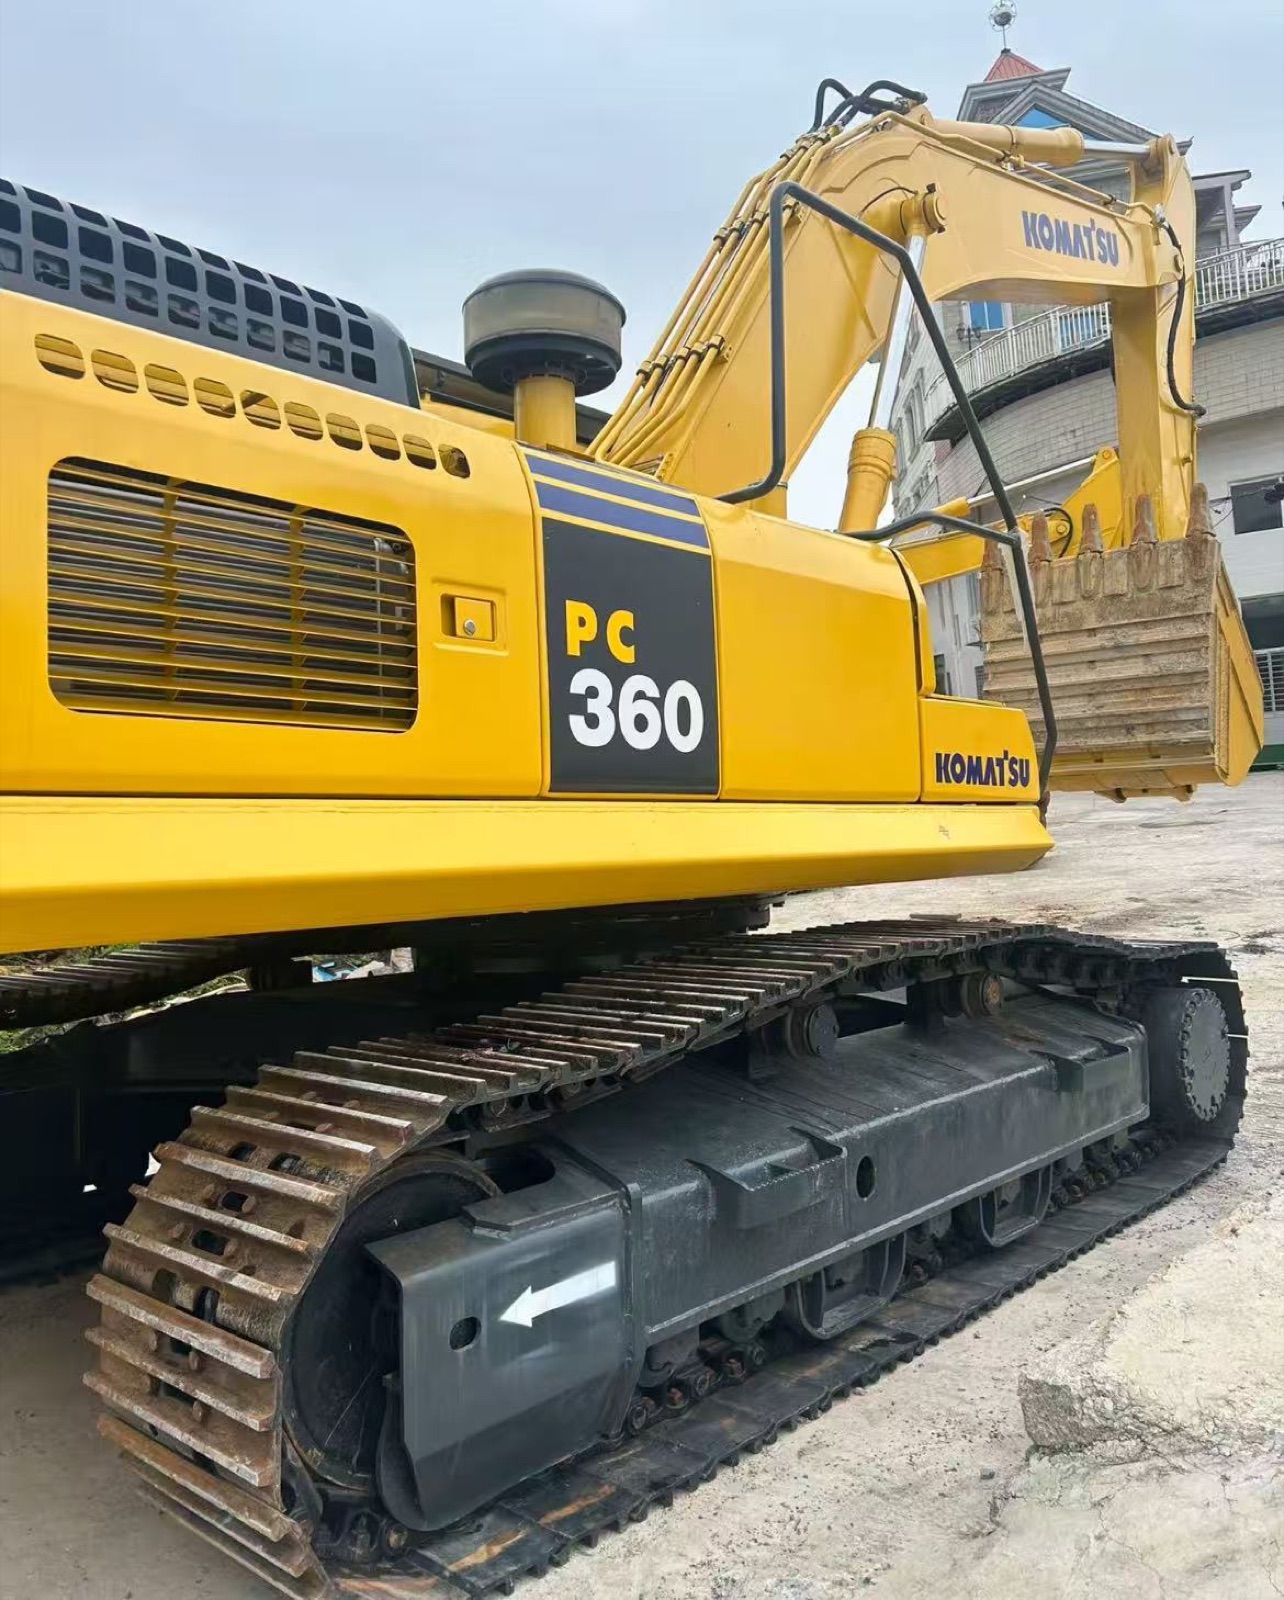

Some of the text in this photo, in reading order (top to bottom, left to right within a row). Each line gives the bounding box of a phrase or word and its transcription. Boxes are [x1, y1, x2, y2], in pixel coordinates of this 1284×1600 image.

[1021, 210, 1119, 267] KOMATSU
[565, 599, 635, 664] PC
[568, 667, 704, 753] 360
[935, 750, 1030, 788] KOMATSU
